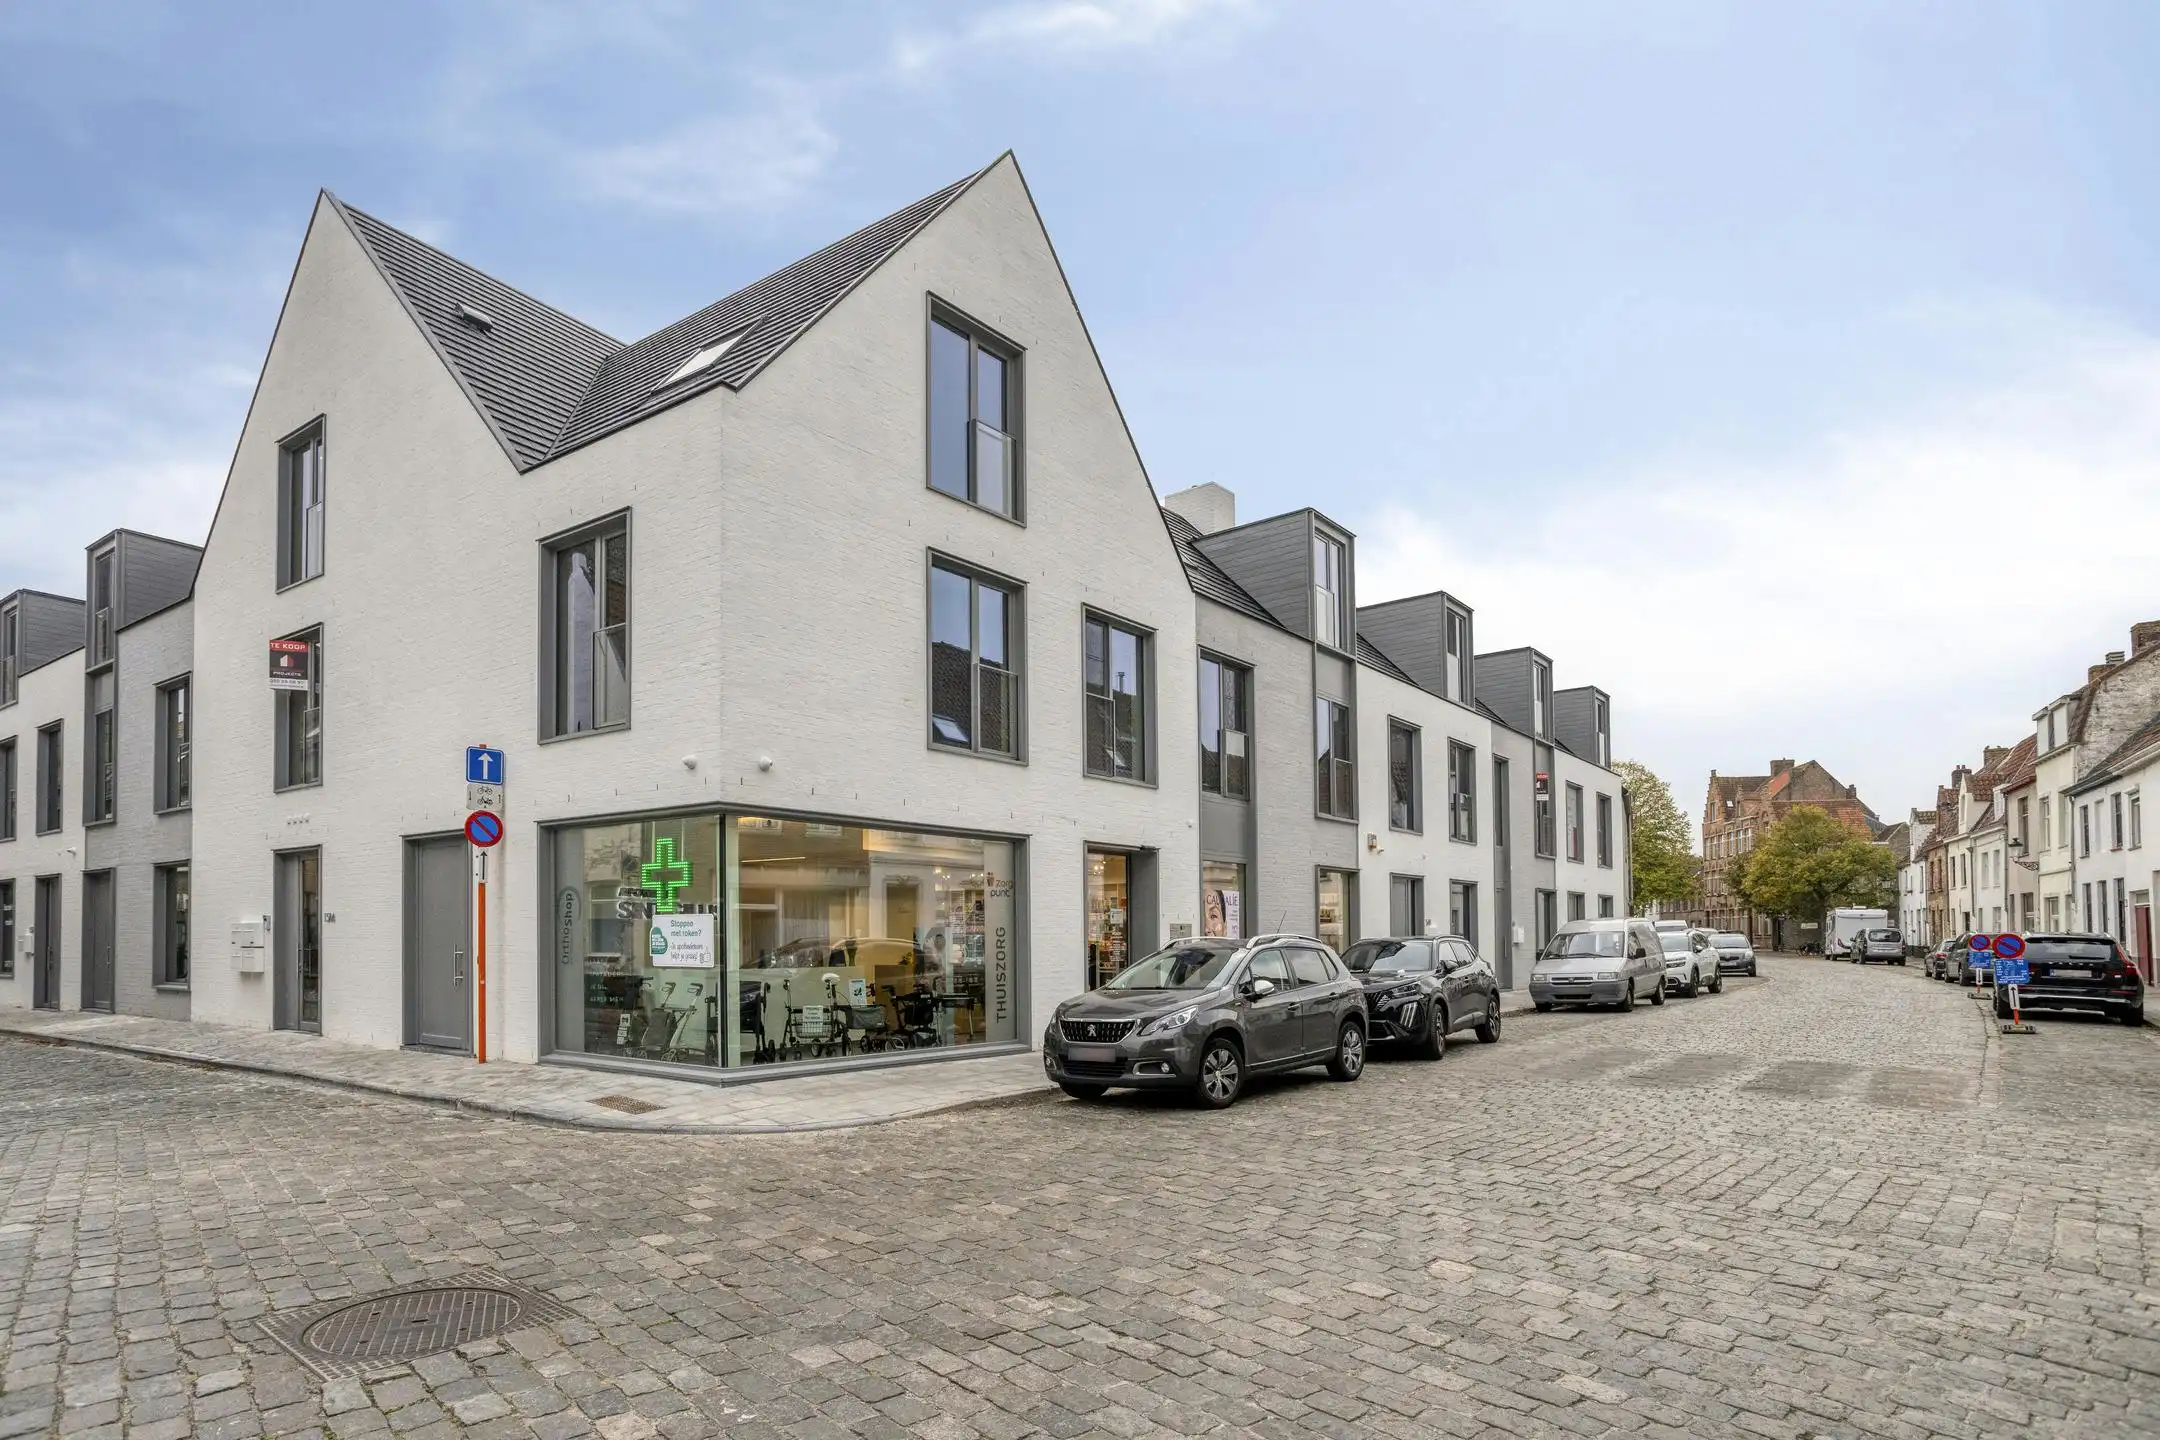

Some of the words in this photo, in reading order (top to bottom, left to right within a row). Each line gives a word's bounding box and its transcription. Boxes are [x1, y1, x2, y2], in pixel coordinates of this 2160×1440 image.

[670, 919, 694, 929] Stoppen
[683, 928, 702, 937] roken?
[995, 926, 1007, 1024] THUISZORG
